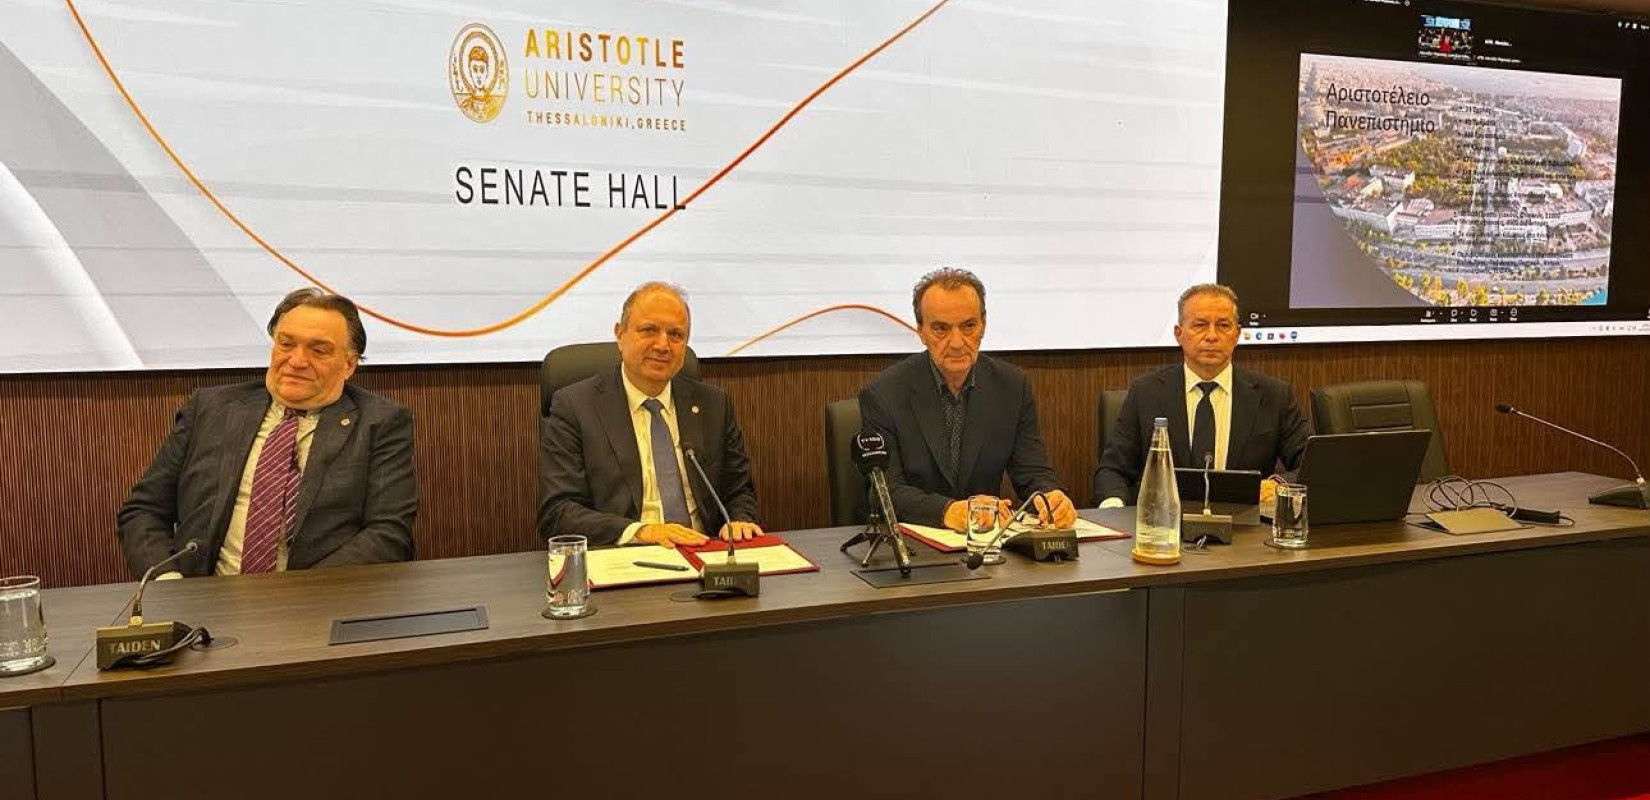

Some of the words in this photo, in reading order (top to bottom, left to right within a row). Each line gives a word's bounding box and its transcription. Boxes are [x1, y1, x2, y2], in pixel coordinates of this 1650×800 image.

[525, 28, 685, 69] ARISTOTLE
[524, 68, 685, 107] UNIVERSITY
[1326, 82, 1430, 106] Αριστοτέλειο
[1325, 110, 1435, 136] Πανεπιστήμιο
[455, 166, 591, 208] SENATE
[608, 173, 687, 210] HALL
[108, 639, 161, 654] TAIDEN
